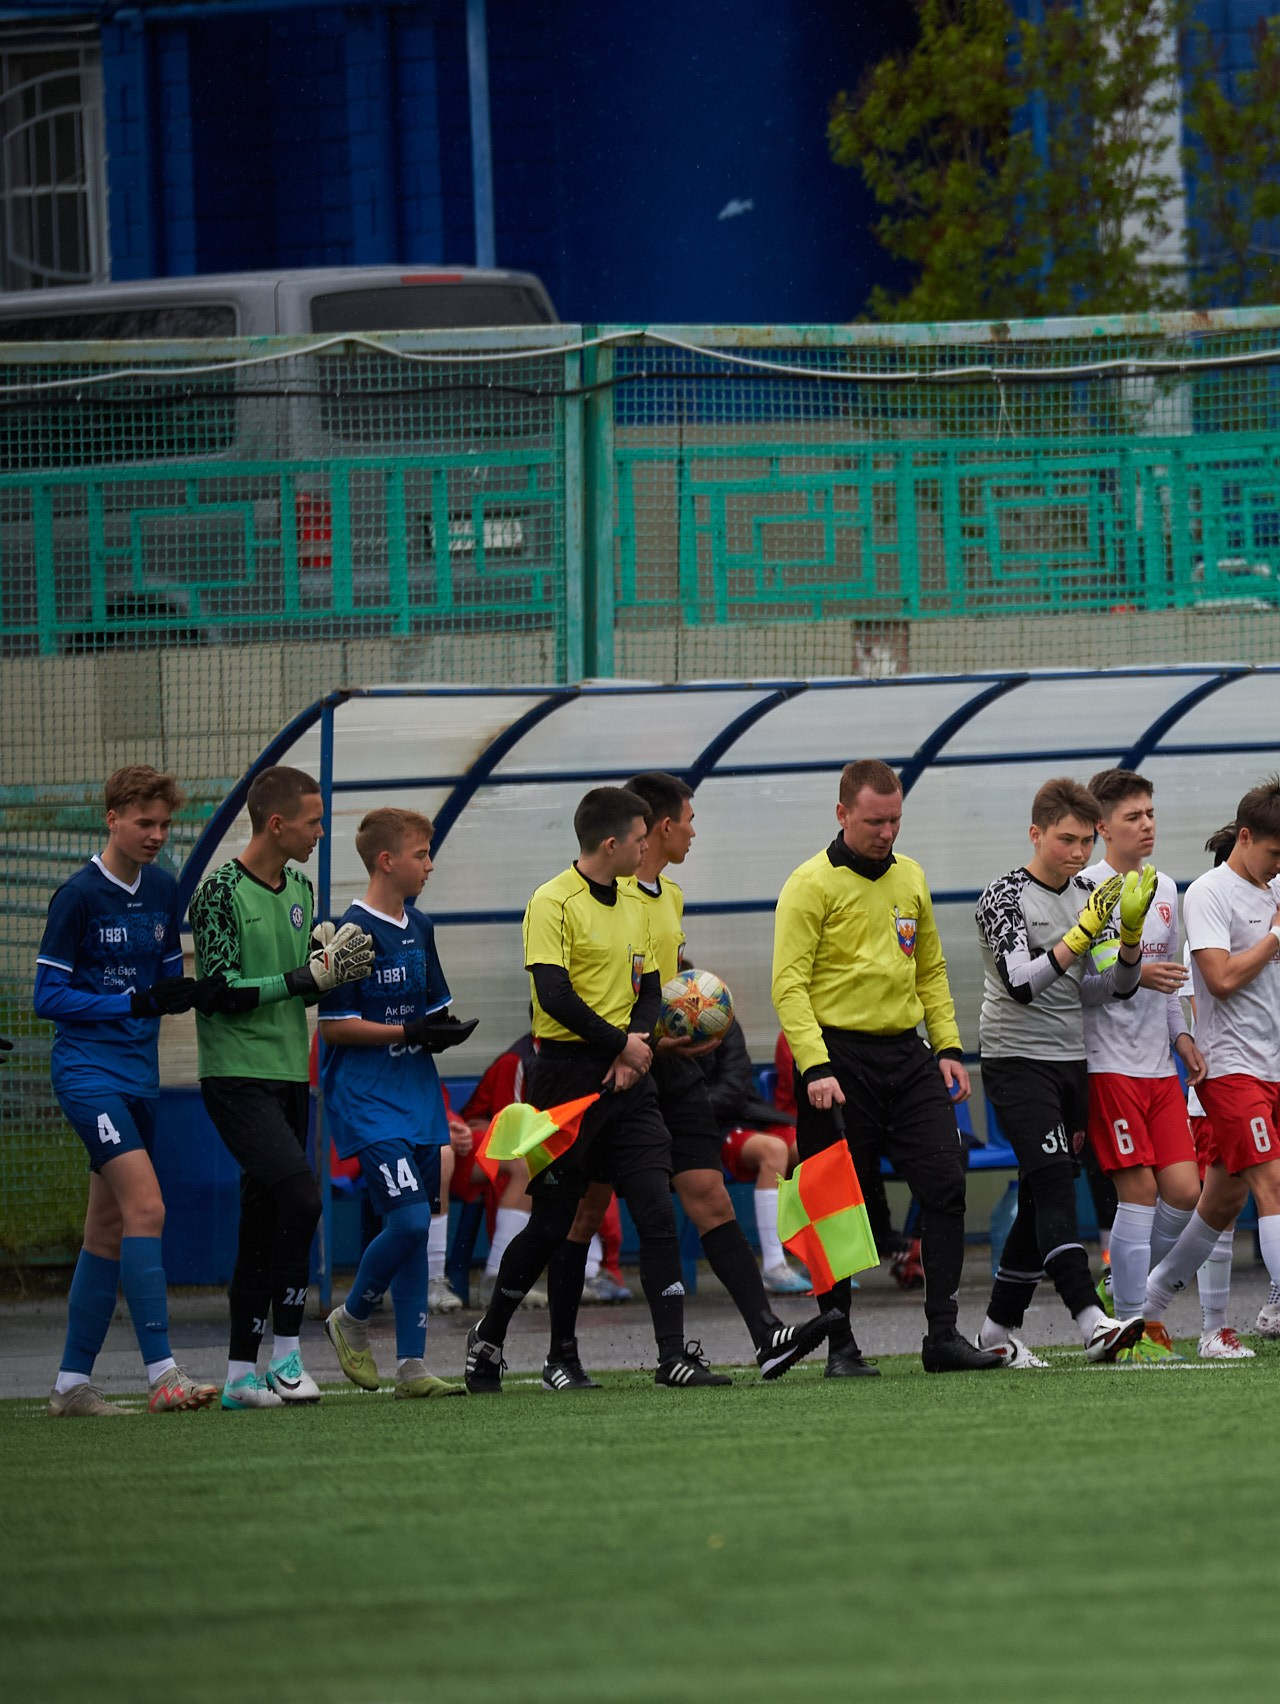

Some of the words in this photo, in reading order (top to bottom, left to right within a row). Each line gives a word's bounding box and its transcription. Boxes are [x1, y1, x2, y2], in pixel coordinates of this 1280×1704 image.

[99, 927, 127, 943] 1981
[104, 966, 116, 975] Ак
[376, 966, 407, 984] 1981
[103, 977, 126, 986] Банк
[385, 1006, 398, 1016] Ак
[97, 1112, 121, 1145] 4
[1113, 1118, 1135, 1155] 6
[1250, 1116, 1272, 1153] 8
[379, 1157, 419, 1197] 14
